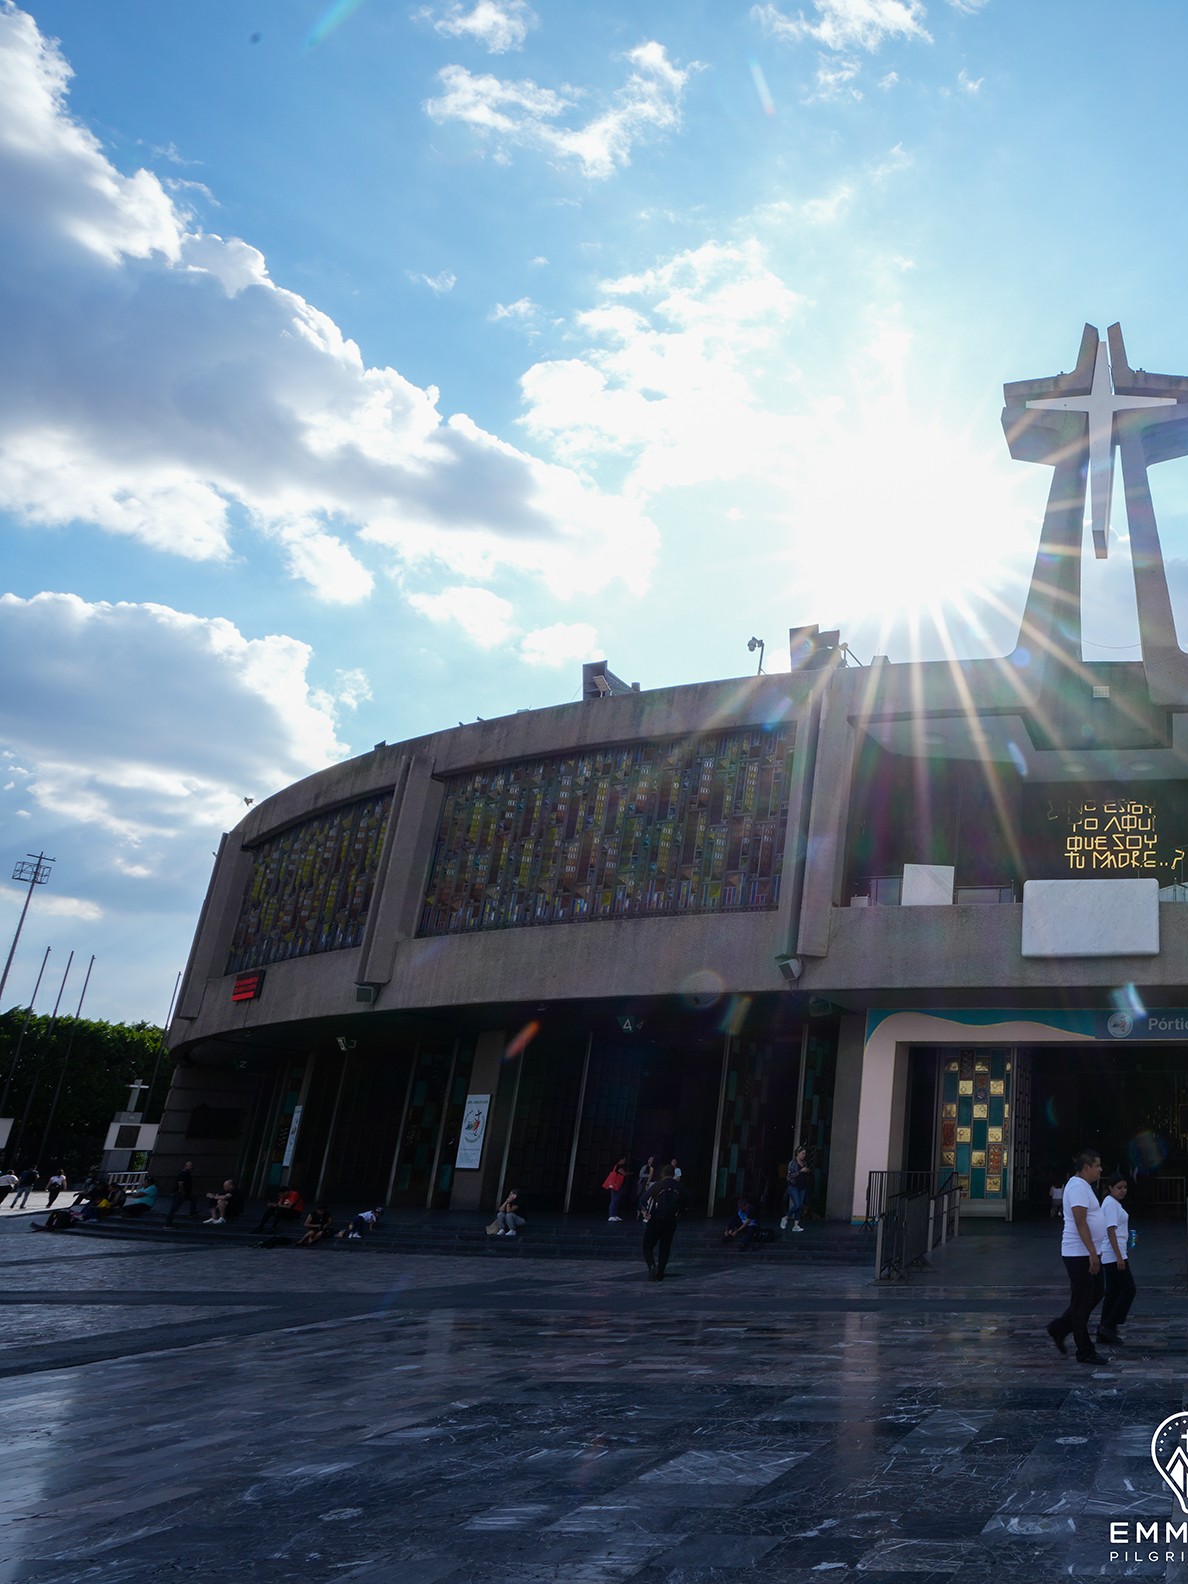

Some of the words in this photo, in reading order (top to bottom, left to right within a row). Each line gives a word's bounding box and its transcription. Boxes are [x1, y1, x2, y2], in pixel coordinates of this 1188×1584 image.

[1066, 836, 1108, 852] QUE
[1112, 834, 1157, 849] SOY
[1064, 851, 1085, 869] TU
[623, 1019, 632, 1031] 4
